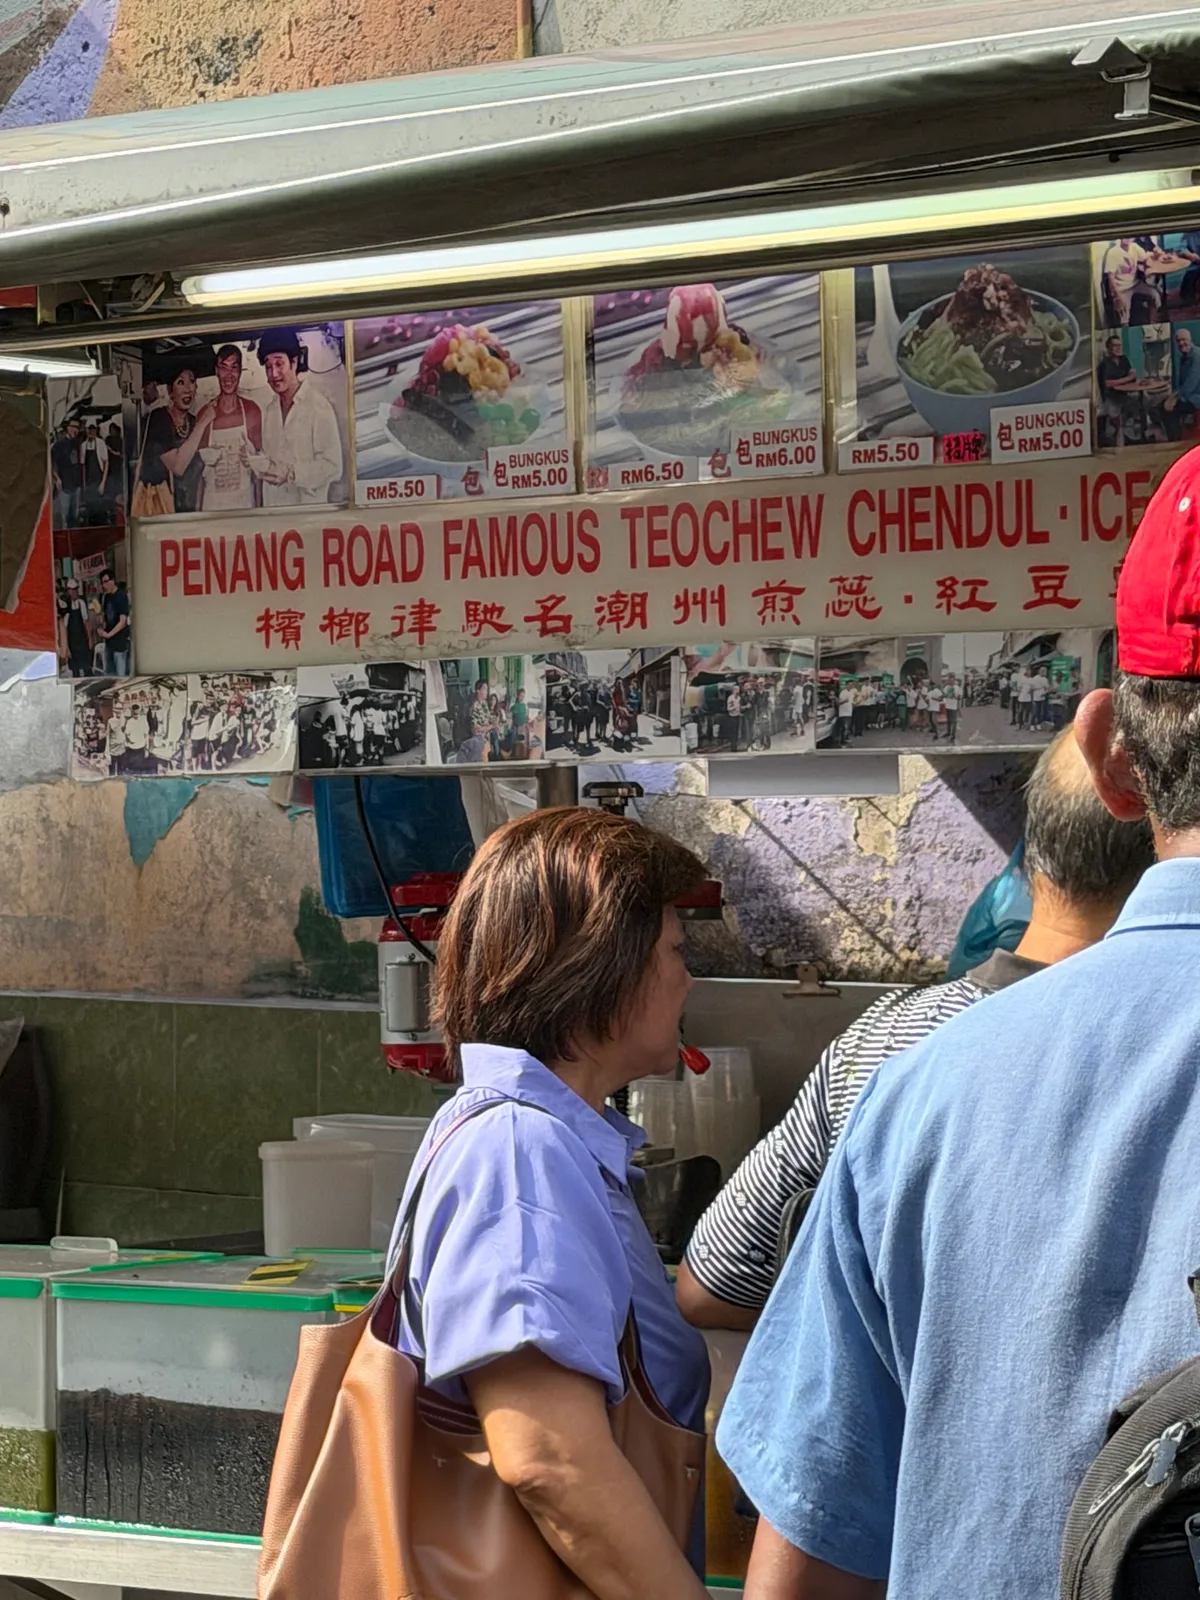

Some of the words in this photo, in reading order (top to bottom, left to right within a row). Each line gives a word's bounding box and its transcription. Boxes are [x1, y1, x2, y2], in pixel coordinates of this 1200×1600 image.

[1014, 408, 1086, 432] BUNGKUS
[752, 426, 818, 447] BUNGKUS
[997, 422, 1015, 451] 包
[1018, 428, 1084, 453] RM5.00
[509, 449, 569, 469] BUNGKUS
[707, 448, 732, 478] 包
[736, 437, 753, 466] 包
[755, 445, 816, 469] RM6.00
[851, 442, 919, 465] RM5.50
[461, 466, 485, 496] 包
[493, 460, 509, 487] 包
[511, 467, 568, 490] RM5.00
[620, 461, 684, 485] RM6.50
[367, 479, 425, 501] RM5.50
[159, 529, 306, 598] PENANG
[321, 522, 425, 588] ROAD
[442, 508, 601, 581] FAMOUS
[620, 493, 825, 569] TEOCHEW
[847, 478, 1050, 557] CHENDUL
